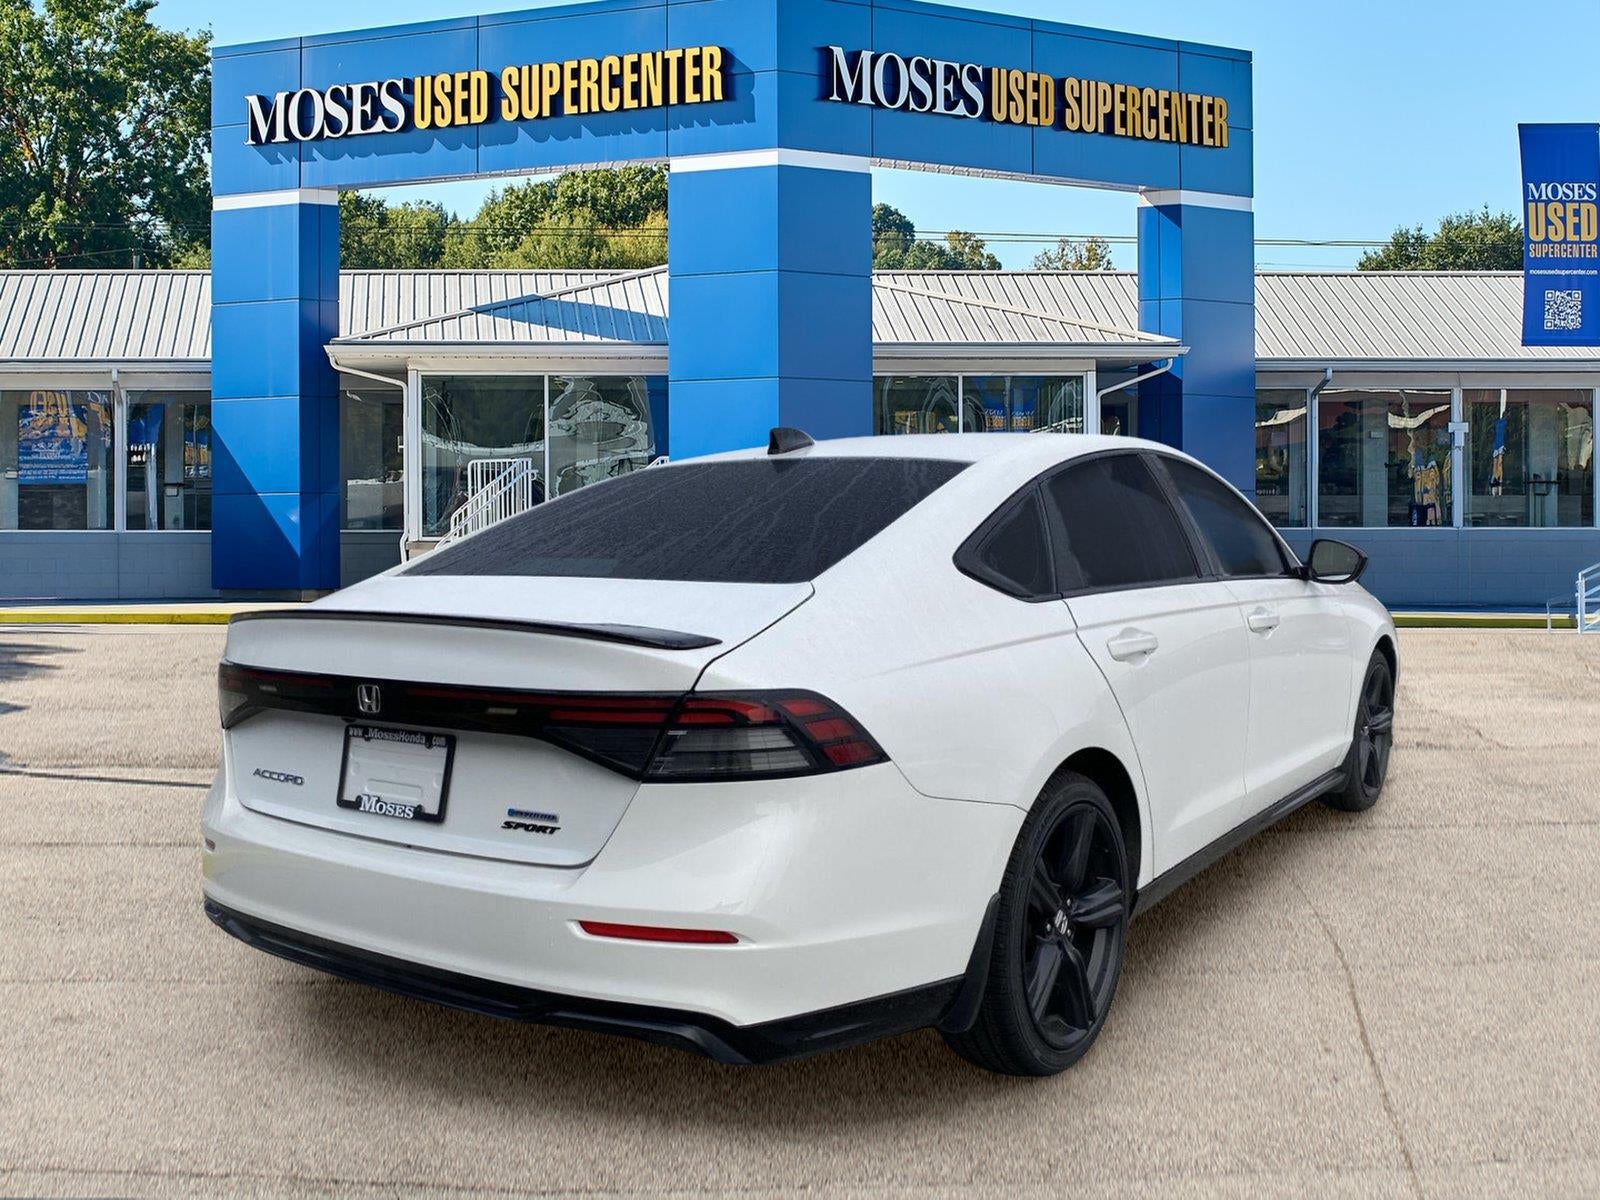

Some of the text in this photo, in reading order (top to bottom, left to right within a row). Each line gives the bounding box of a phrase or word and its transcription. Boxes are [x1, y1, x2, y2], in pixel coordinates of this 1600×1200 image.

[243, 44, 724, 146] MOSES USED SUPERCENTER
[827, 45, 1230, 149] MOSES USED SUPERCENTER
[1527, 182, 1597, 200] MOSES
[1528, 202, 1598, 242] USED
[1529, 243, 1598, 258] SUPERCENTER
[252, 768, 305, 786] ACCORD
[500, 820, 562, 835] SPORT
